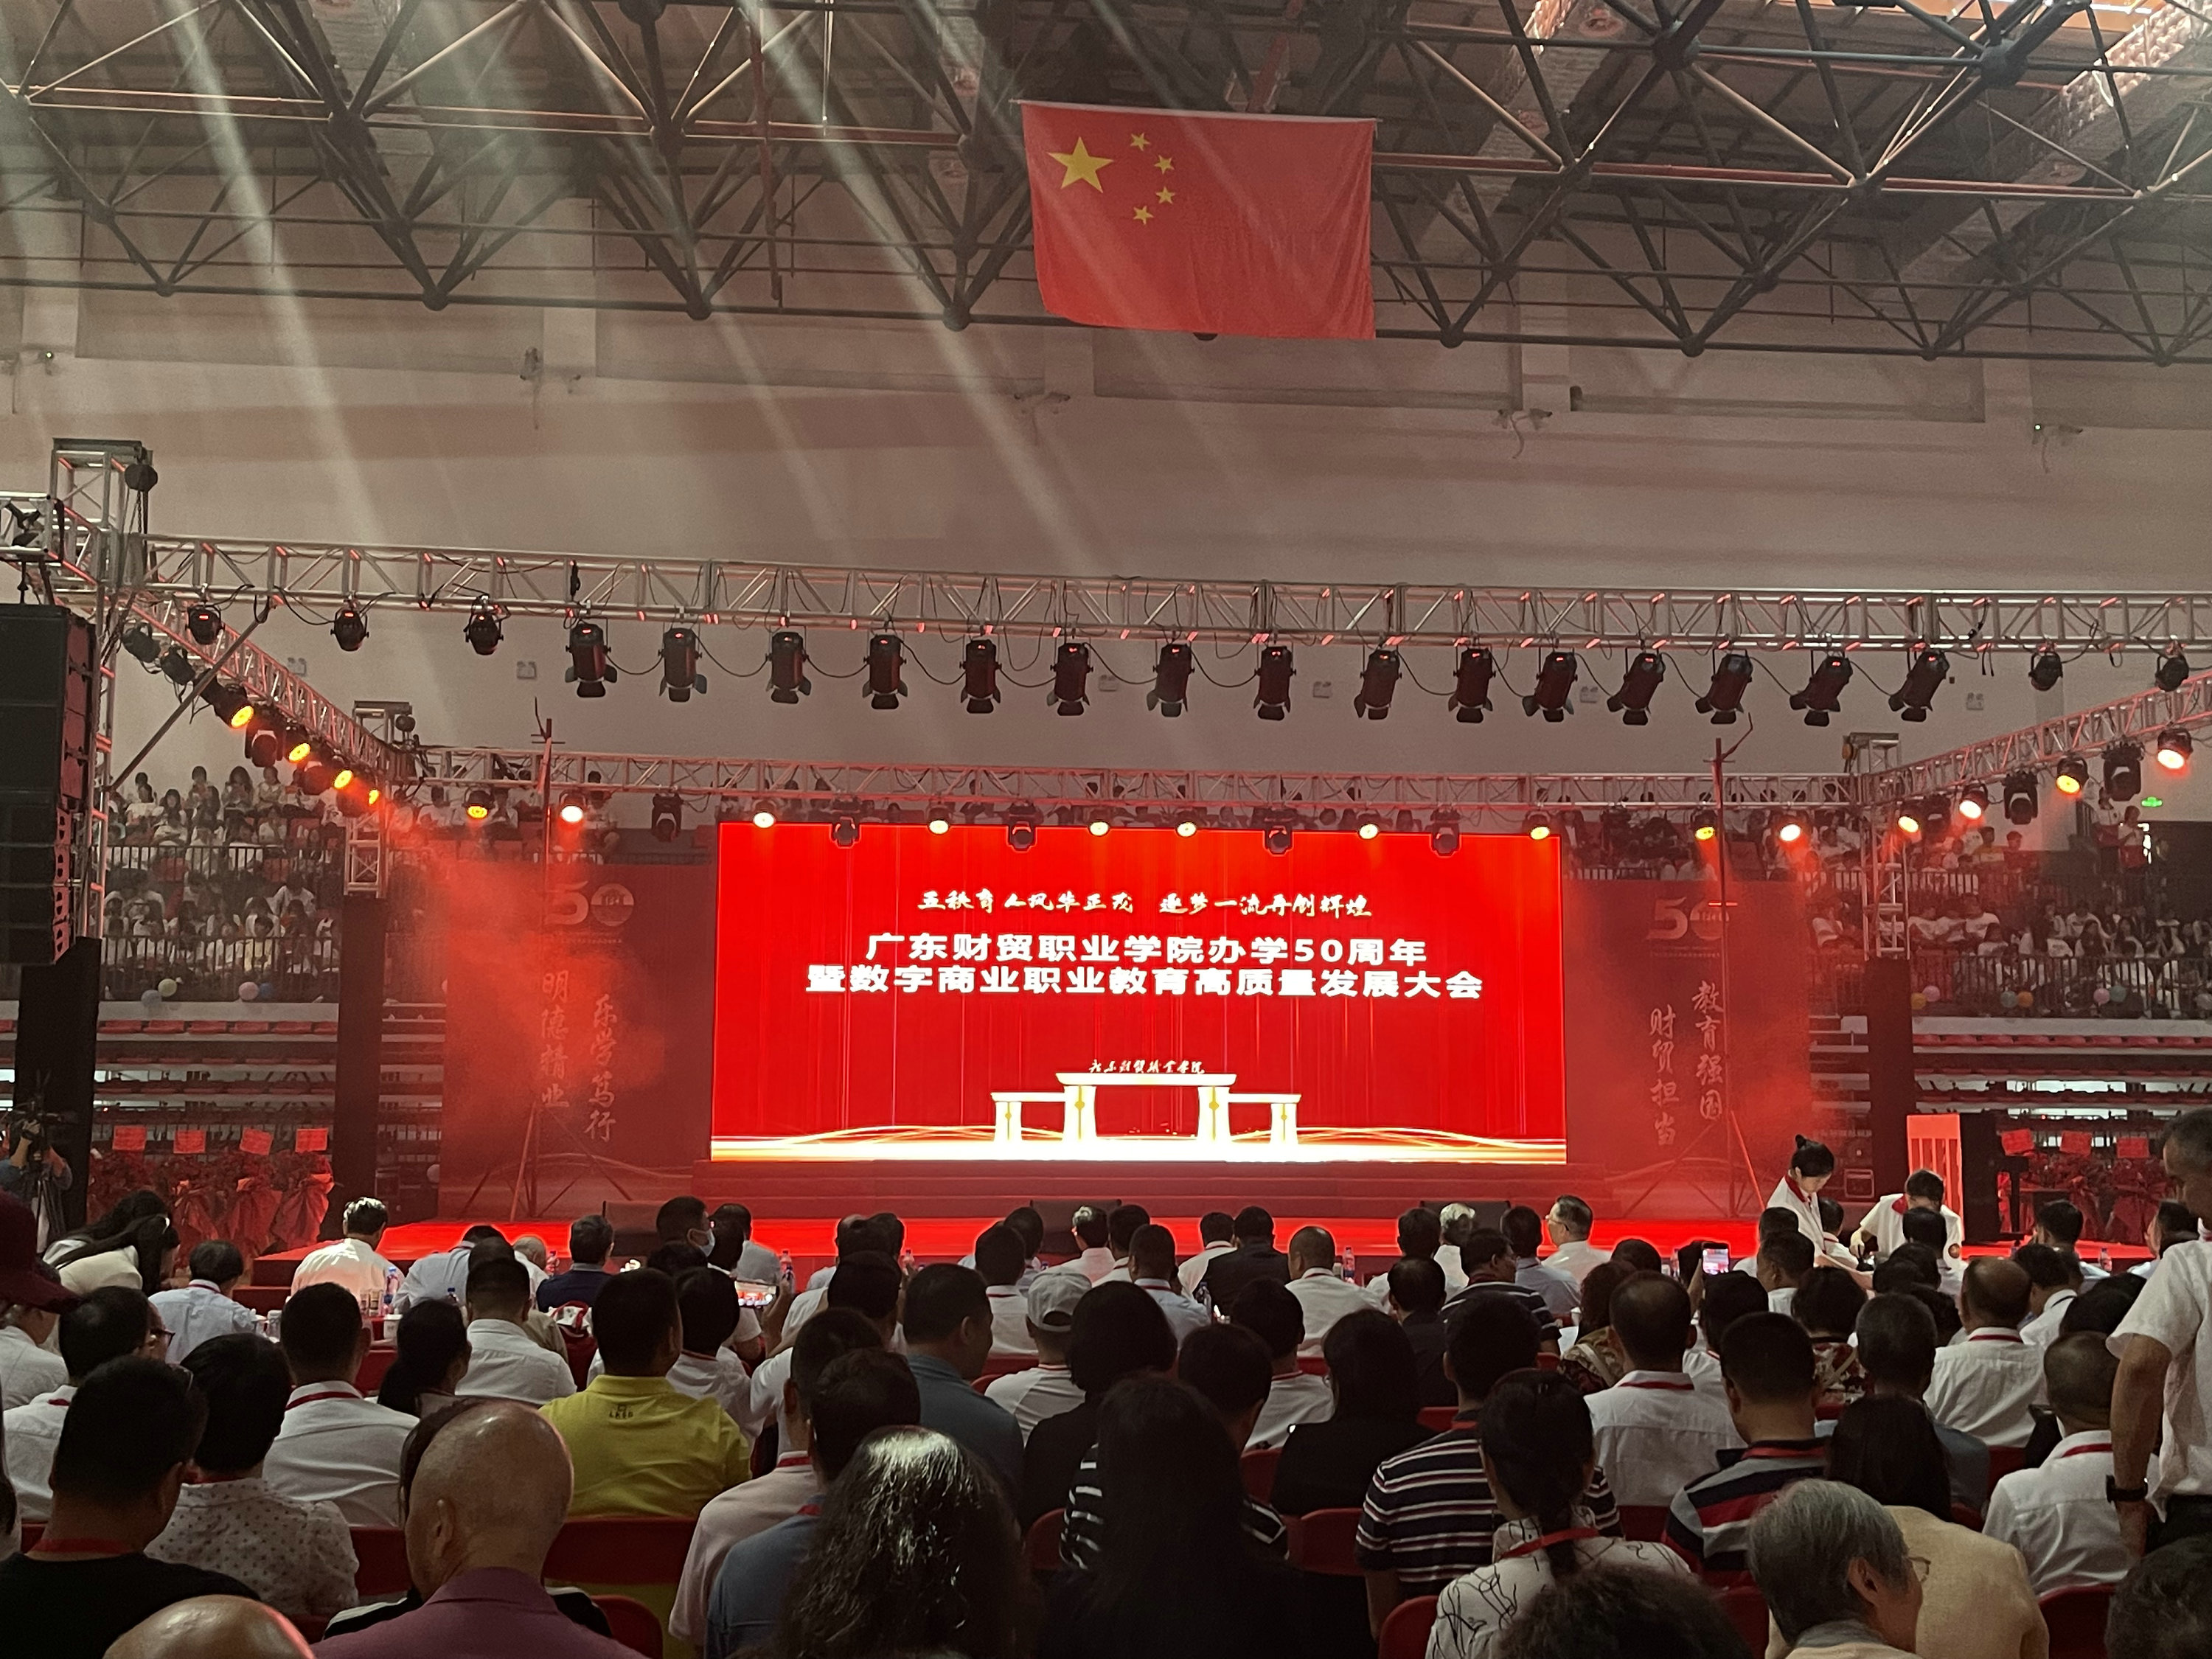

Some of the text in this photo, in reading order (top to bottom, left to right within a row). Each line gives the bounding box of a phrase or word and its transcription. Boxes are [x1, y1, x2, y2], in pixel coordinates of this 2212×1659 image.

[917, 888, 1372, 919] 五秩育人风华正茂 逐梦一流再创辉煌
[866, 932, 1427, 967] 广东财贸职业学院办学50周年
[805, 964, 1483, 998] 暨数字商业职业教育高质量发展大会
[1691, 980, 1724, 1120] 教育强国
